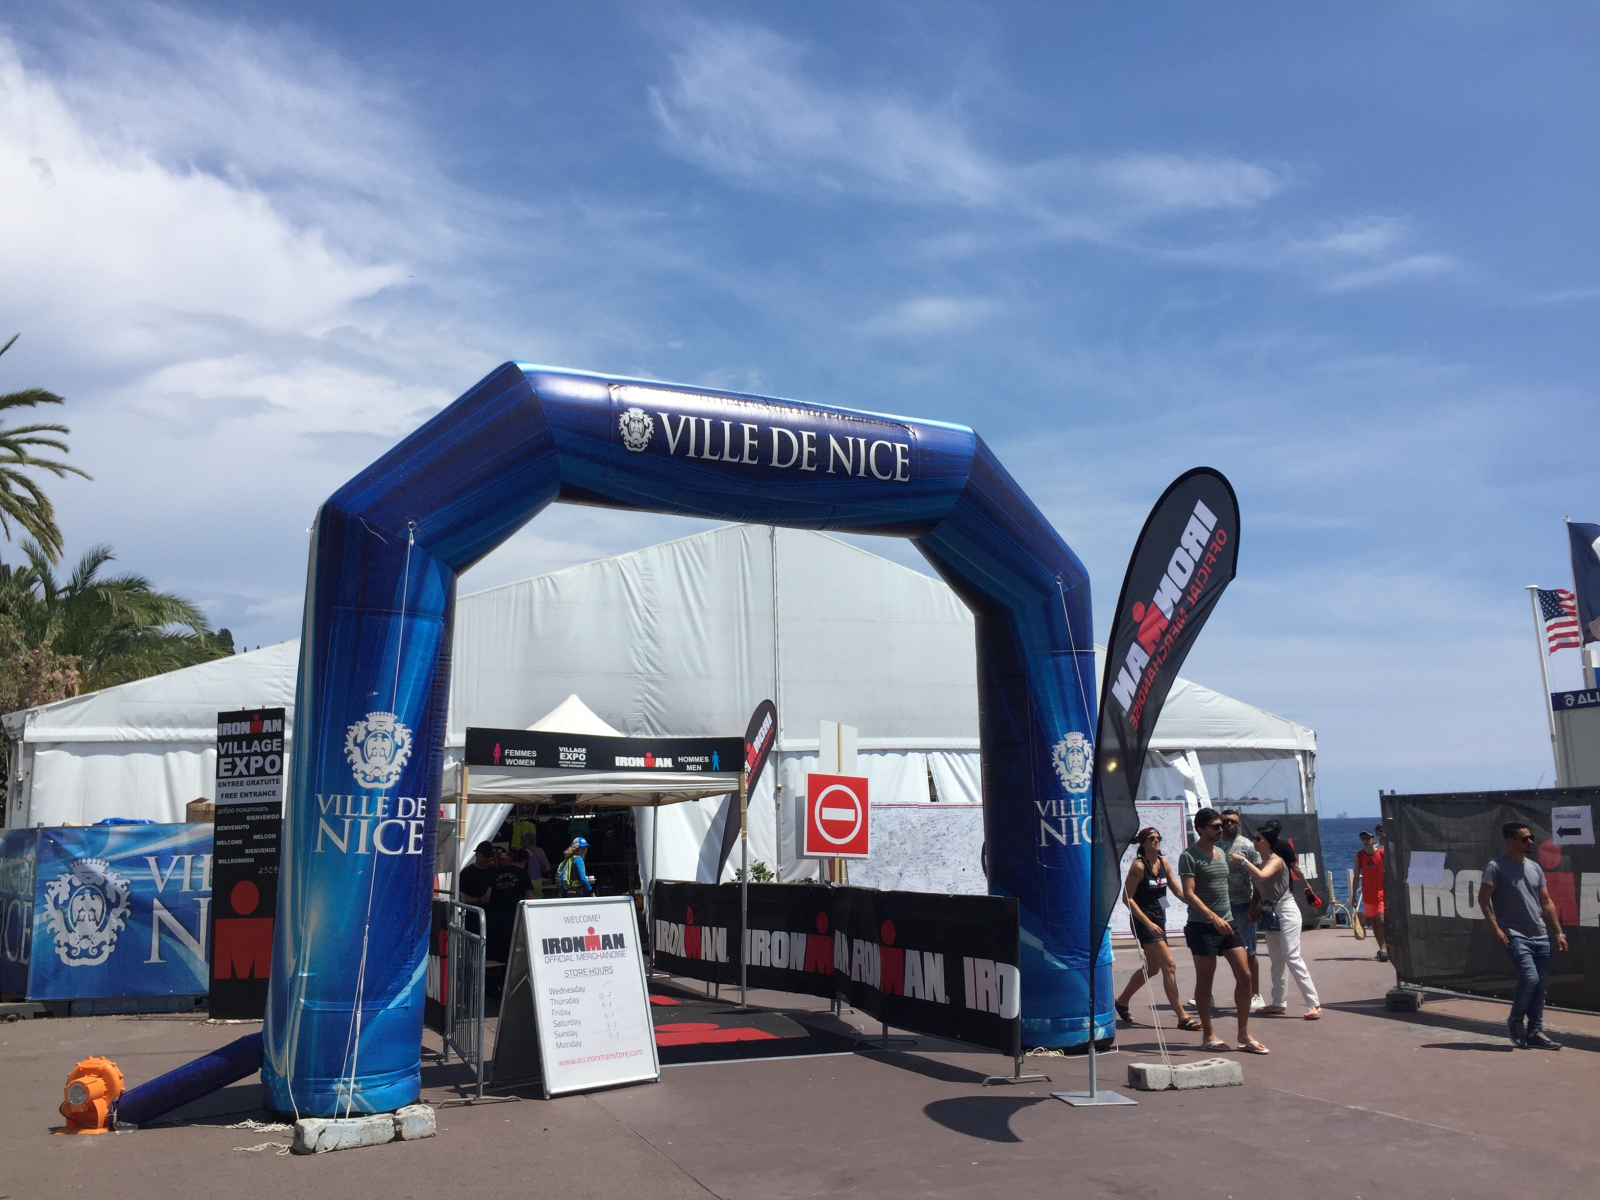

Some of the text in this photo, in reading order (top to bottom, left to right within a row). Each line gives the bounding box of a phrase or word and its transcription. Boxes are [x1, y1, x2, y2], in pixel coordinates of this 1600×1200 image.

[657, 412, 910, 483] VILLE DE NICE
[218, 713, 282, 736] IRONMAN
[218, 738, 282, 755] VILLAGE
[504, 749, 537, 757] FEMMES
[505, 758, 536, 766] WOMEN
[559, 752, 586, 761] EXPO
[615, 752, 673, 768] IRONMAN
[218, 754, 281, 777] EXPO
[217, 778, 280, 788] ENTREE GRATUITE
[239, 790, 277, 798] ENTRANCE
[315, 793, 427, 818] VILLE DE
[1034, 798, 1088, 817] VILLE
[313, 816, 425, 855] NICE
[563, 915, 601, 924] WELCOME!
[542, 926, 626, 955] IRONMAN
[655, 906, 728, 963] IRONMAN
[741, 911, 850, 976] IRONMAN
[544, 950, 627, 964] OFFICIAL MERCHANDISE
[564, 966, 614, 978] STORE HOURS
[548, 986, 586, 995] Wednesday
[550, 997, 580, 1006] Thursday
[551, 1009, 571, 1017] Friday
[552, 1019, 582, 1028] Saturday
[554, 1030, 578, 1039] Sunday
[555, 1040, 582, 1050] Monday
[558, 1049, 644, 1066] www.eu.ironmanstore.com
